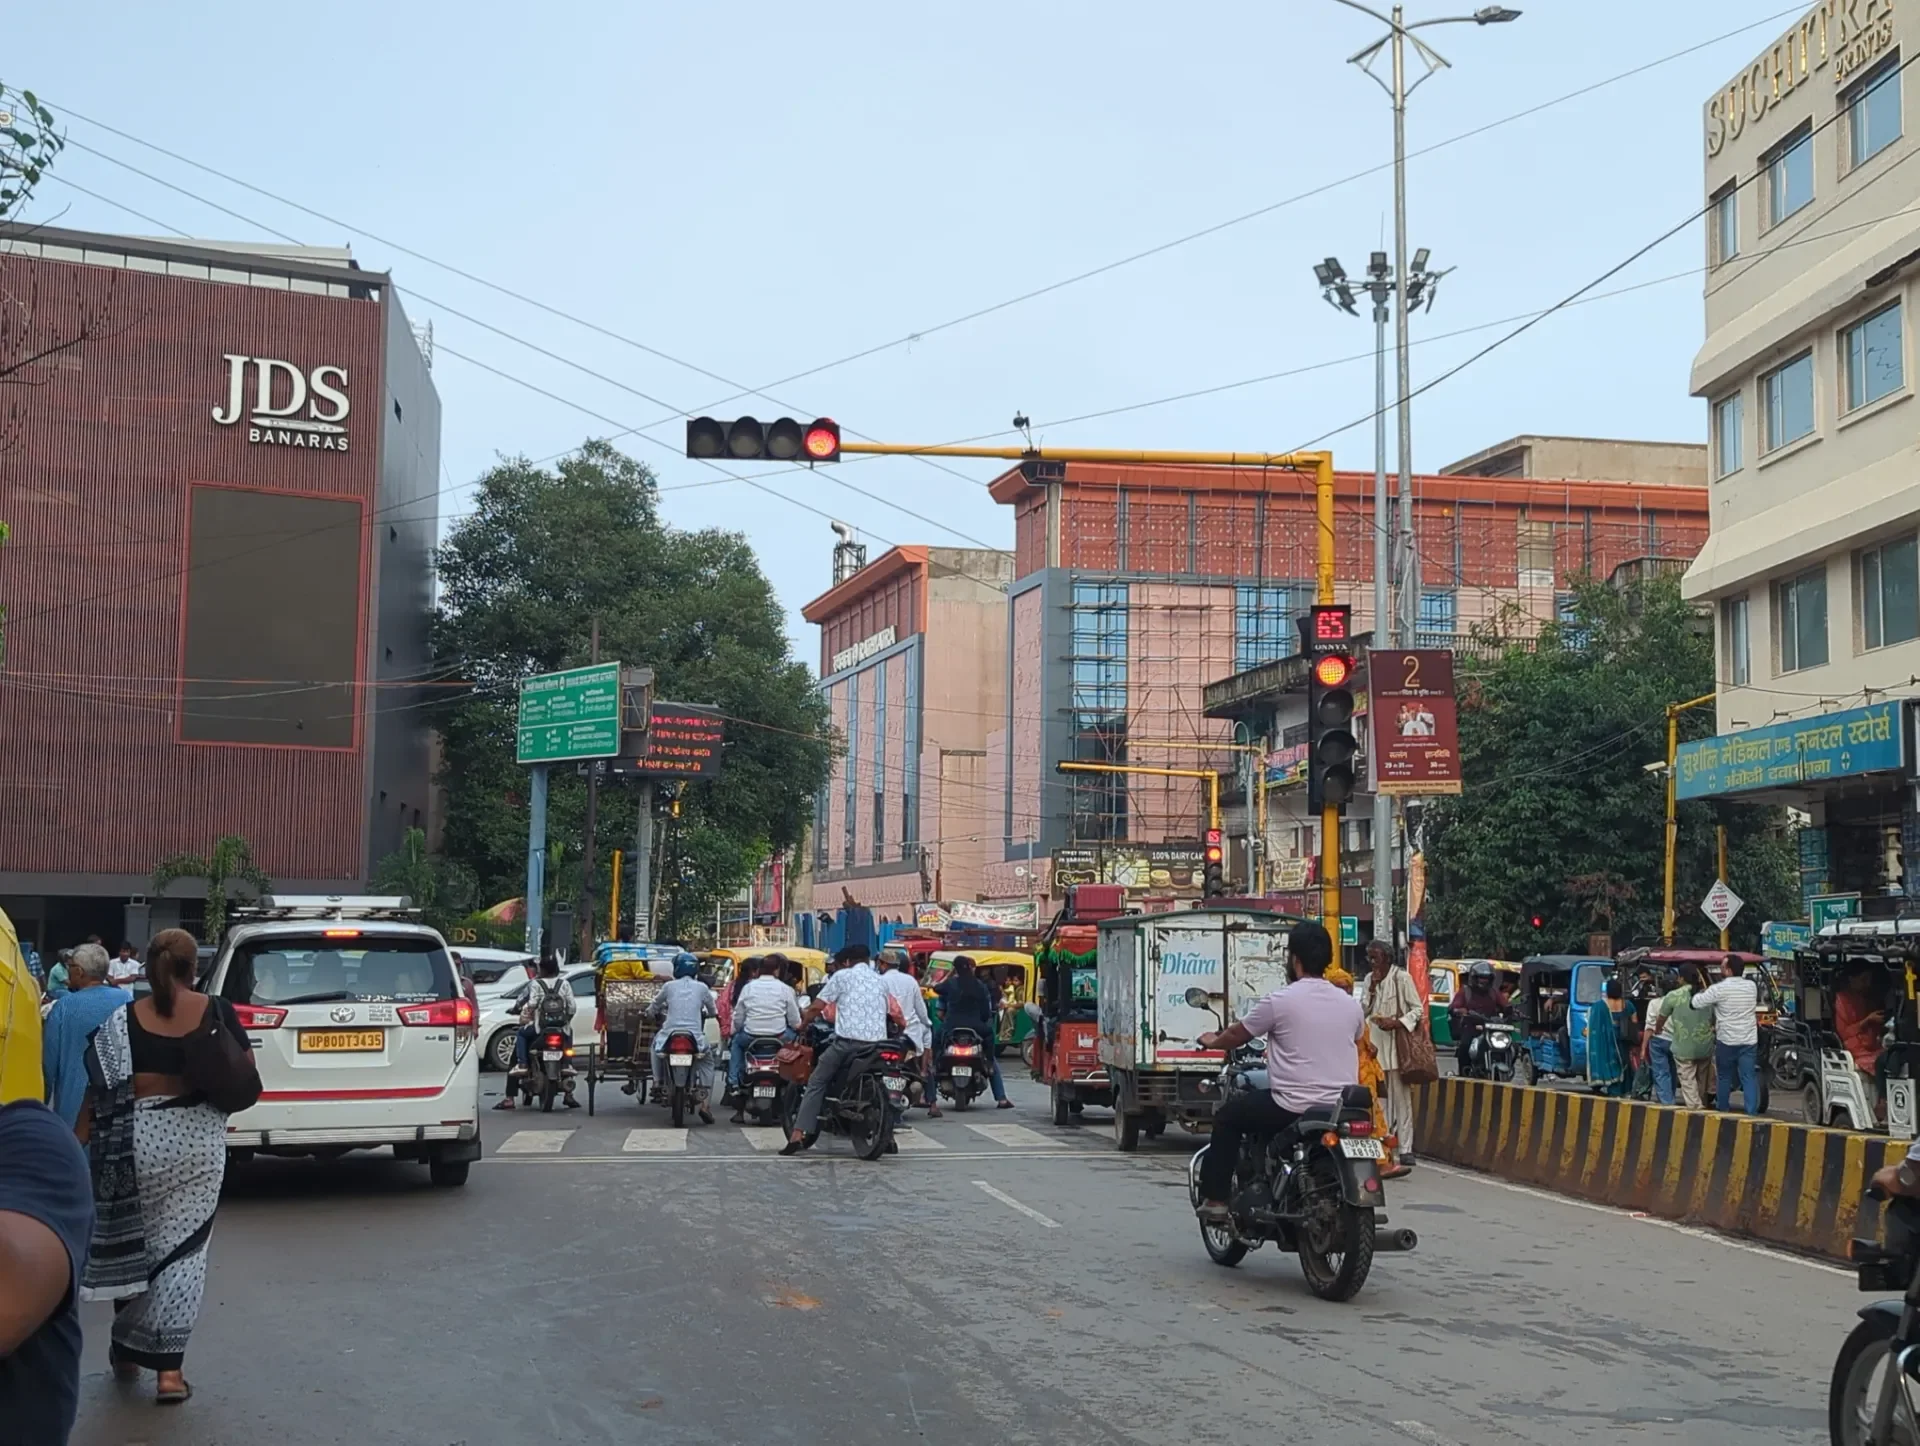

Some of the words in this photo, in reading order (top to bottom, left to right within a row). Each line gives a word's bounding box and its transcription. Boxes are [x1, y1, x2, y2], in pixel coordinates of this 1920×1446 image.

[1834, 18, 1893, 84] PRINTS
[211, 353, 350, 425] JDS
[249, 428, 349, 451] BANARAS
[1317, 611, 1344, 638] 65
[1402, 655, 1421, 688] 2
[1681, 743, 1719, 782] सुशील
[1721, 736, 1772, 766] मेडिकल
[1847, 705, 1892, 745] स्टोर्स
[1207, 830, 1220, 843] 65
[1151, 851, 1170, 861] 100%
[1171, 851, 1190, 861] DAIRY
[1190, 851, 1205, 861] CAK
